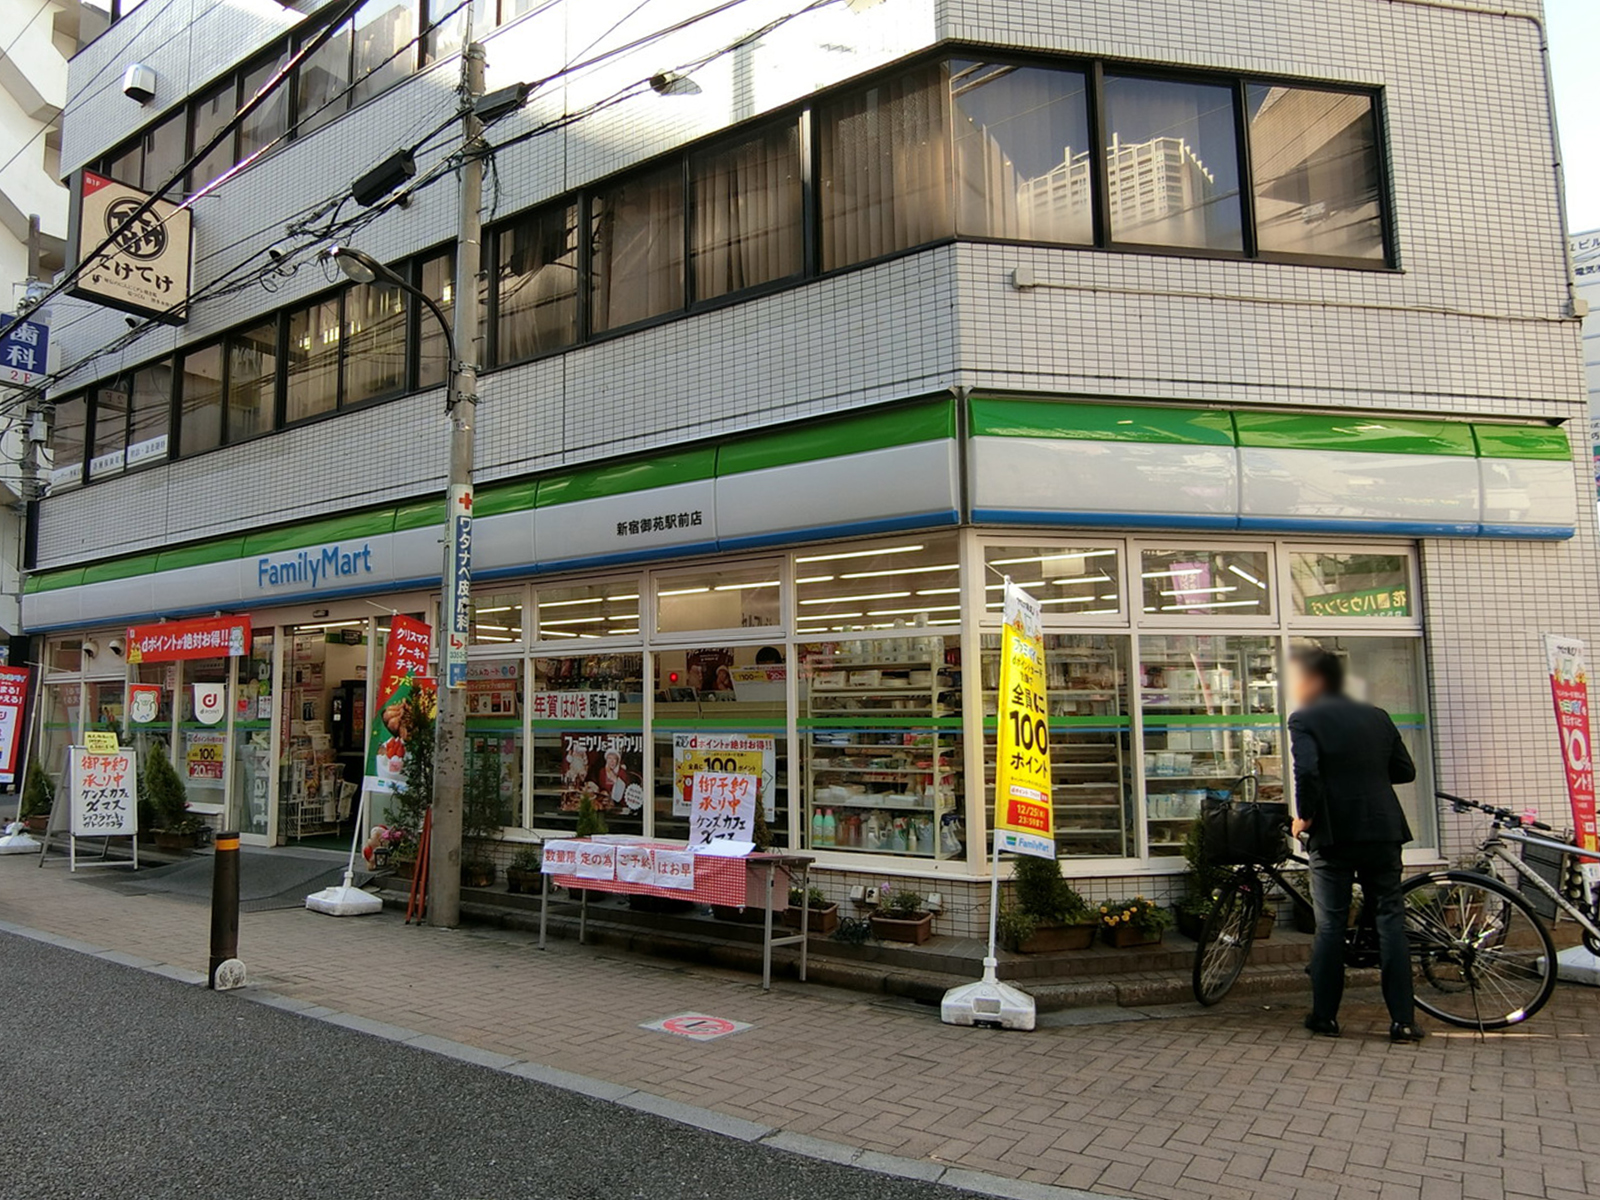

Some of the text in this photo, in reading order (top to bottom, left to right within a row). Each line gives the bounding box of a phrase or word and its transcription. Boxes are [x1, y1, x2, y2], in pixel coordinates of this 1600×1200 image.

[98, 253, 174, 294] てけてけ
[6, 323, 40, 371] 歯科
[616, 510, 703, 537] 新宿御苑駅前店
[258, 543, 372, 588] FamilyMart
[396, 627, 430, 645] クリスマス
[390, 675, 413, 687] ファミ
[534, 693, 617, 719] 年賀はがき販売中
[1011, 683, 1046, 715] 全員に
[1009, 710, 1049, 756] 100
[81, 755, 130, 774] 御予約
[703, 757, 737, 772] 100
[738, 765, 756, 773] ポイント
[1010, 752, 1048, 780] ポイント
[698, 775, 750, 797] 御予約
[1018, 837, 1050, 853] FamilyMart
